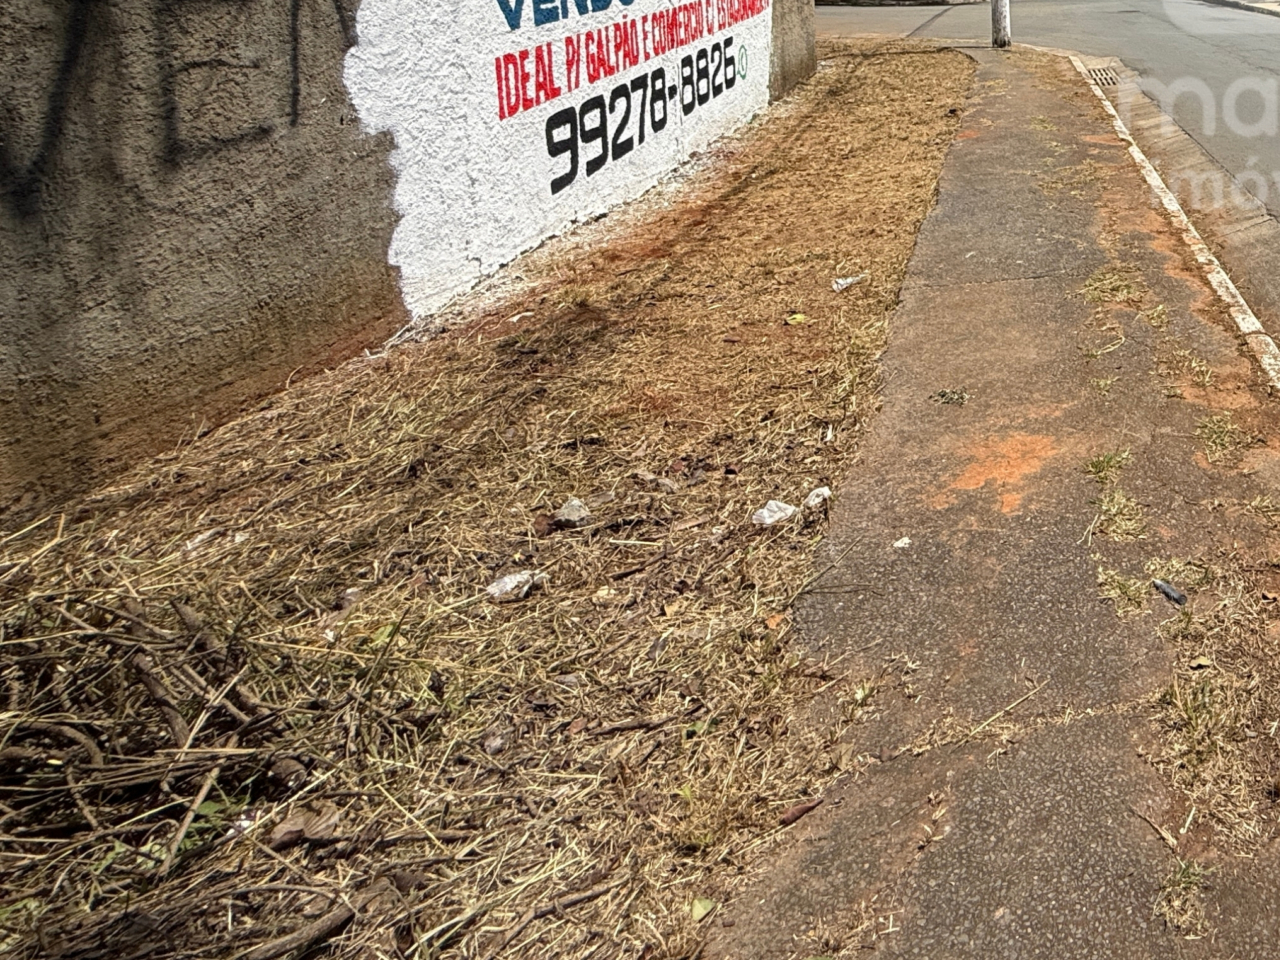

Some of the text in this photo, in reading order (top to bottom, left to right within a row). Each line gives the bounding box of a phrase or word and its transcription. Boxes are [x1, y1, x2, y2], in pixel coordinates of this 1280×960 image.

[495, 42, 561, 120] IDEAL
[565, 34, 580, 93] P/
[585, 14, 640, 84] GALPÃO
[642, 15, 650, 62] E
[546, 36, 736, 195] 99278-8826
